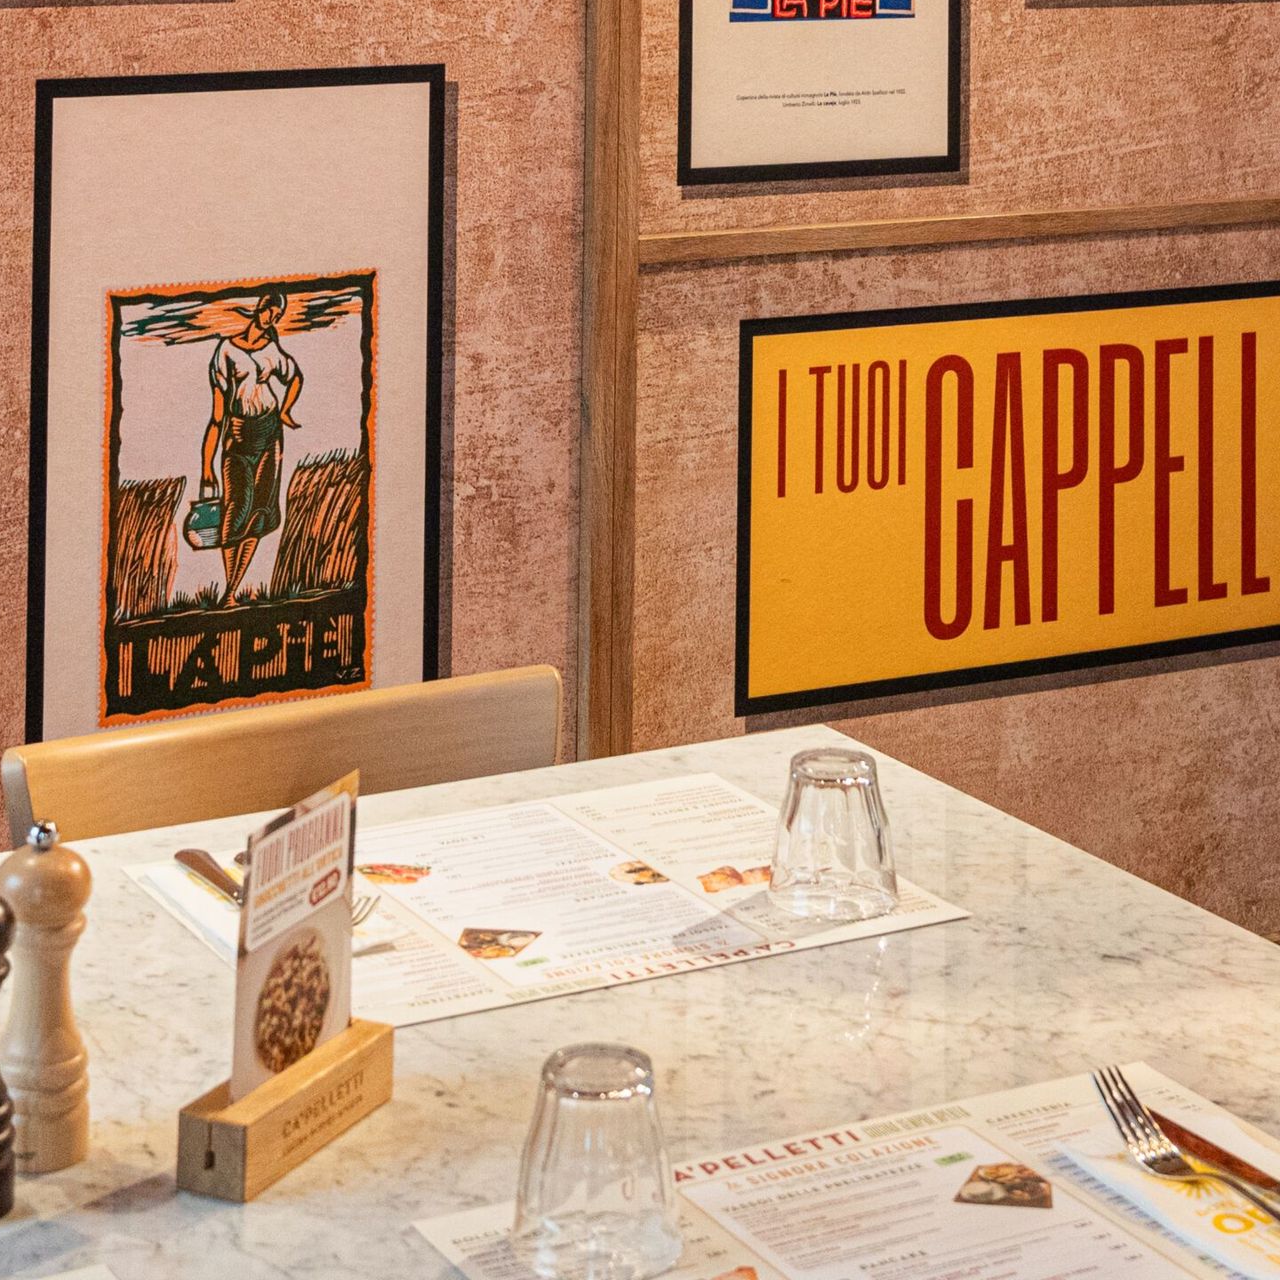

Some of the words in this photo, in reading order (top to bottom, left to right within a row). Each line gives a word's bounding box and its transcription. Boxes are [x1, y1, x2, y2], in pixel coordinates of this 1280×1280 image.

[777, 368, 787, 498] I
[808, 358, 908, 495] TUOI
[673, 1129, 862, 1182] A'PELLETTI
